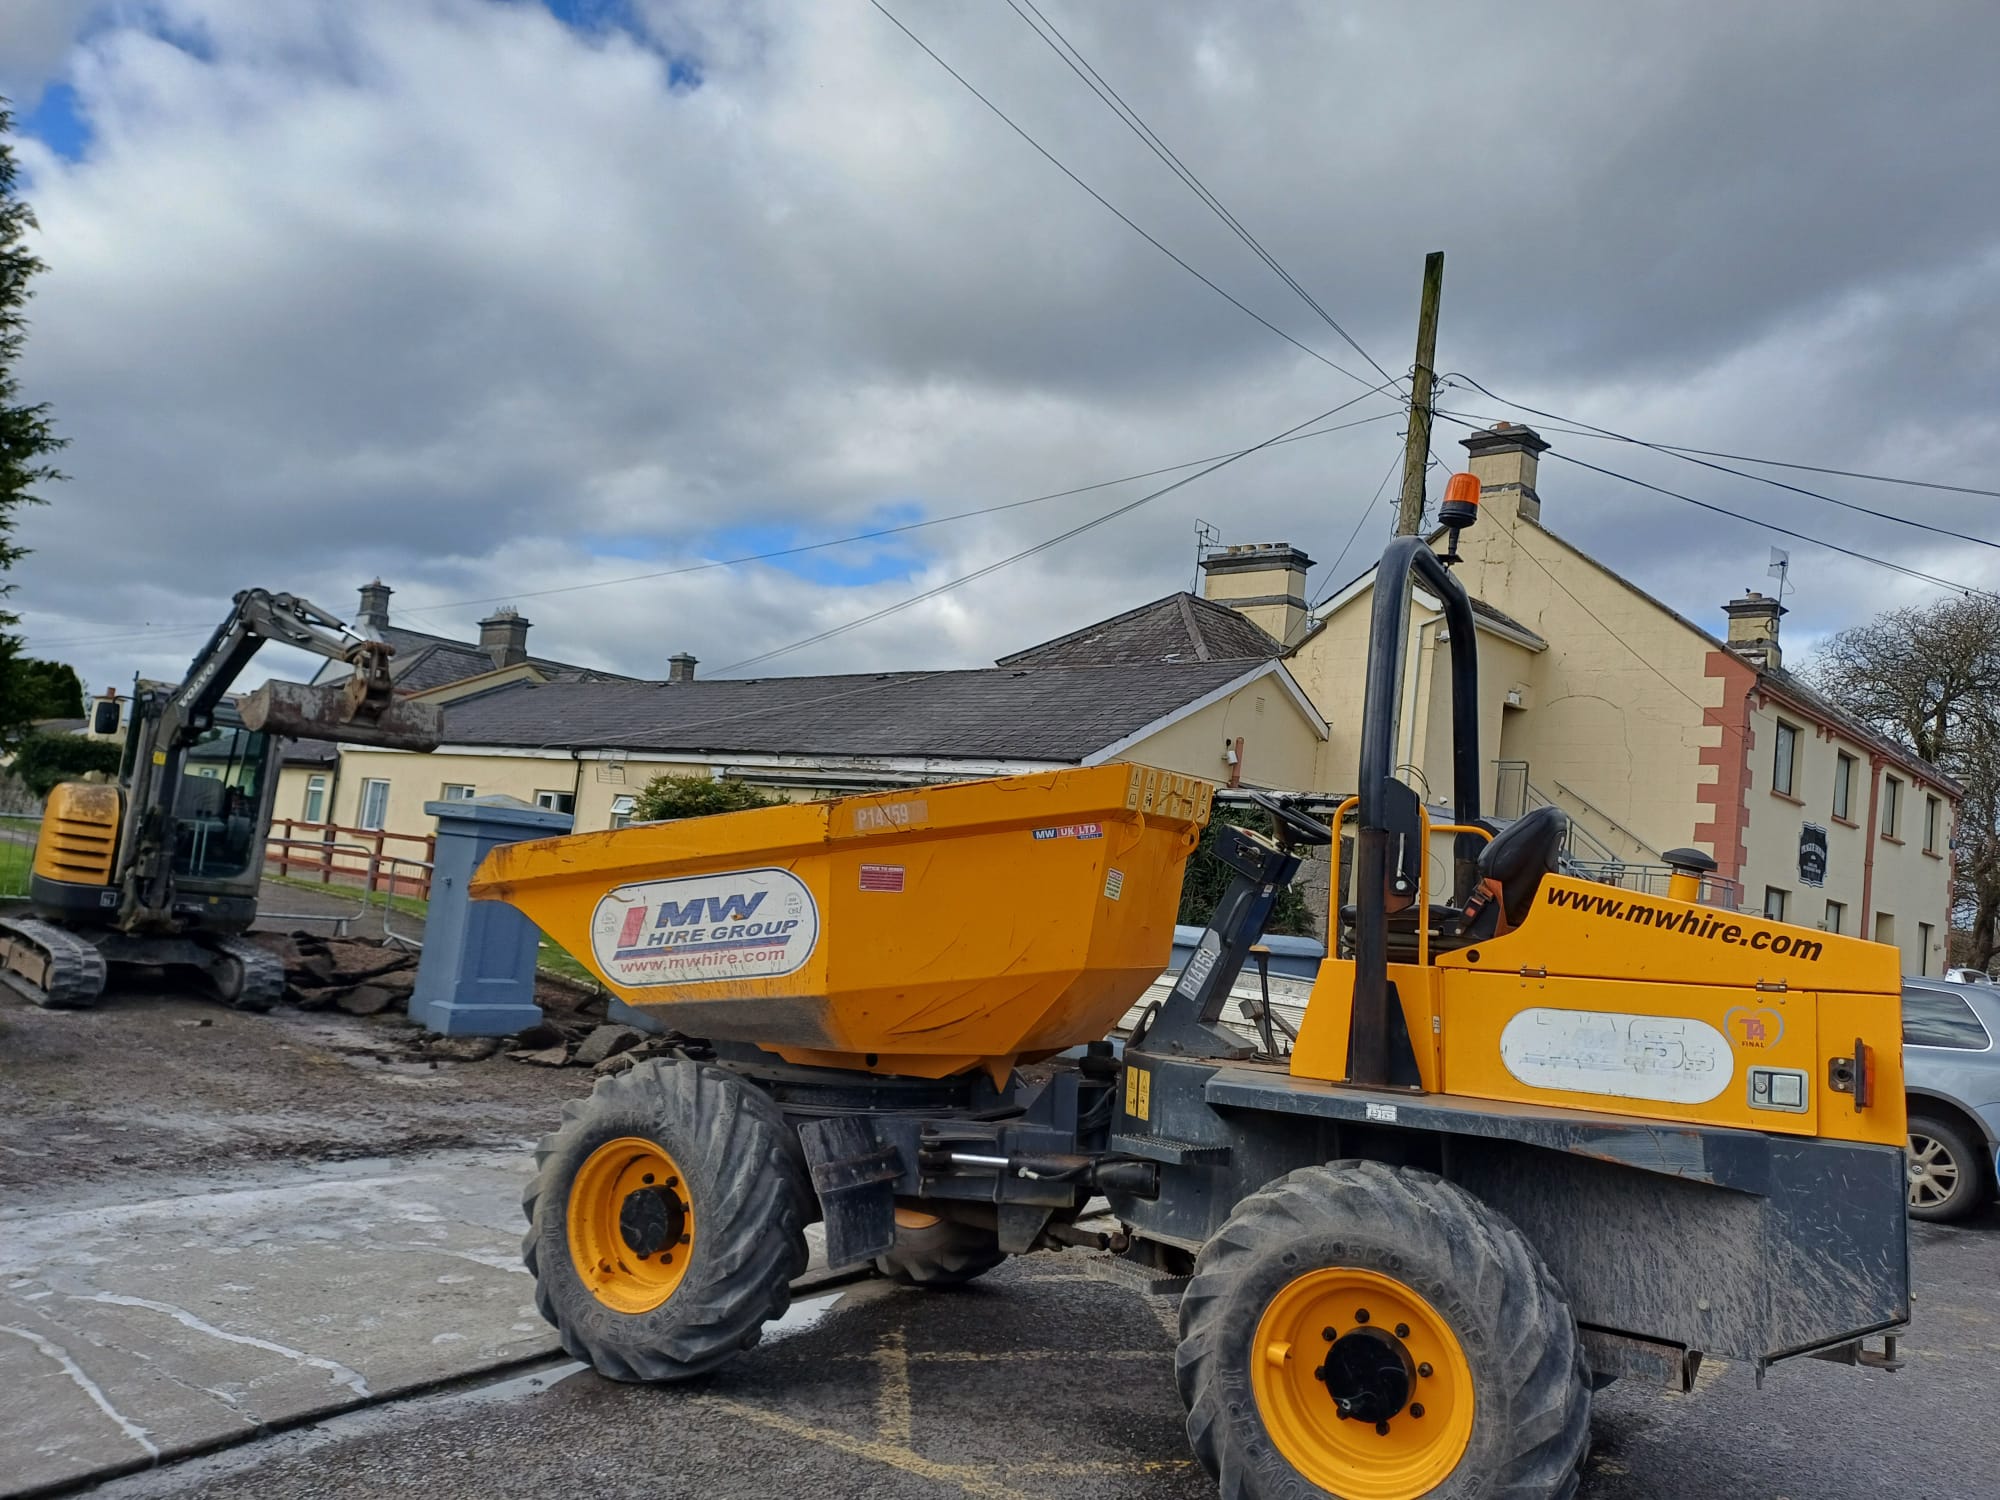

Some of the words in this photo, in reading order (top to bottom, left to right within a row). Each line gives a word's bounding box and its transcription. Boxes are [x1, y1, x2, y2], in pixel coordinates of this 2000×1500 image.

[179, 663, 215, 707] VOLVO
[857, 803, 909, 831] P14159
[1035, 829, 1055, 839] MW
[1060, 826, 1074, 836] UK
[1078, 824, 1097, 834] LTD
[655, 891, 768, 929] MW
[1546, 886, 1824, 962] www.mwhire.com
[648, 927, 704, 946] HIRE
[710, 919, 799, 940] GROUP
[620, 949, 785, 973] www.mwhire.com
[1181, 948, 1217, 995] P14159
[1741, 1041, 1765, 1049] FINAL
